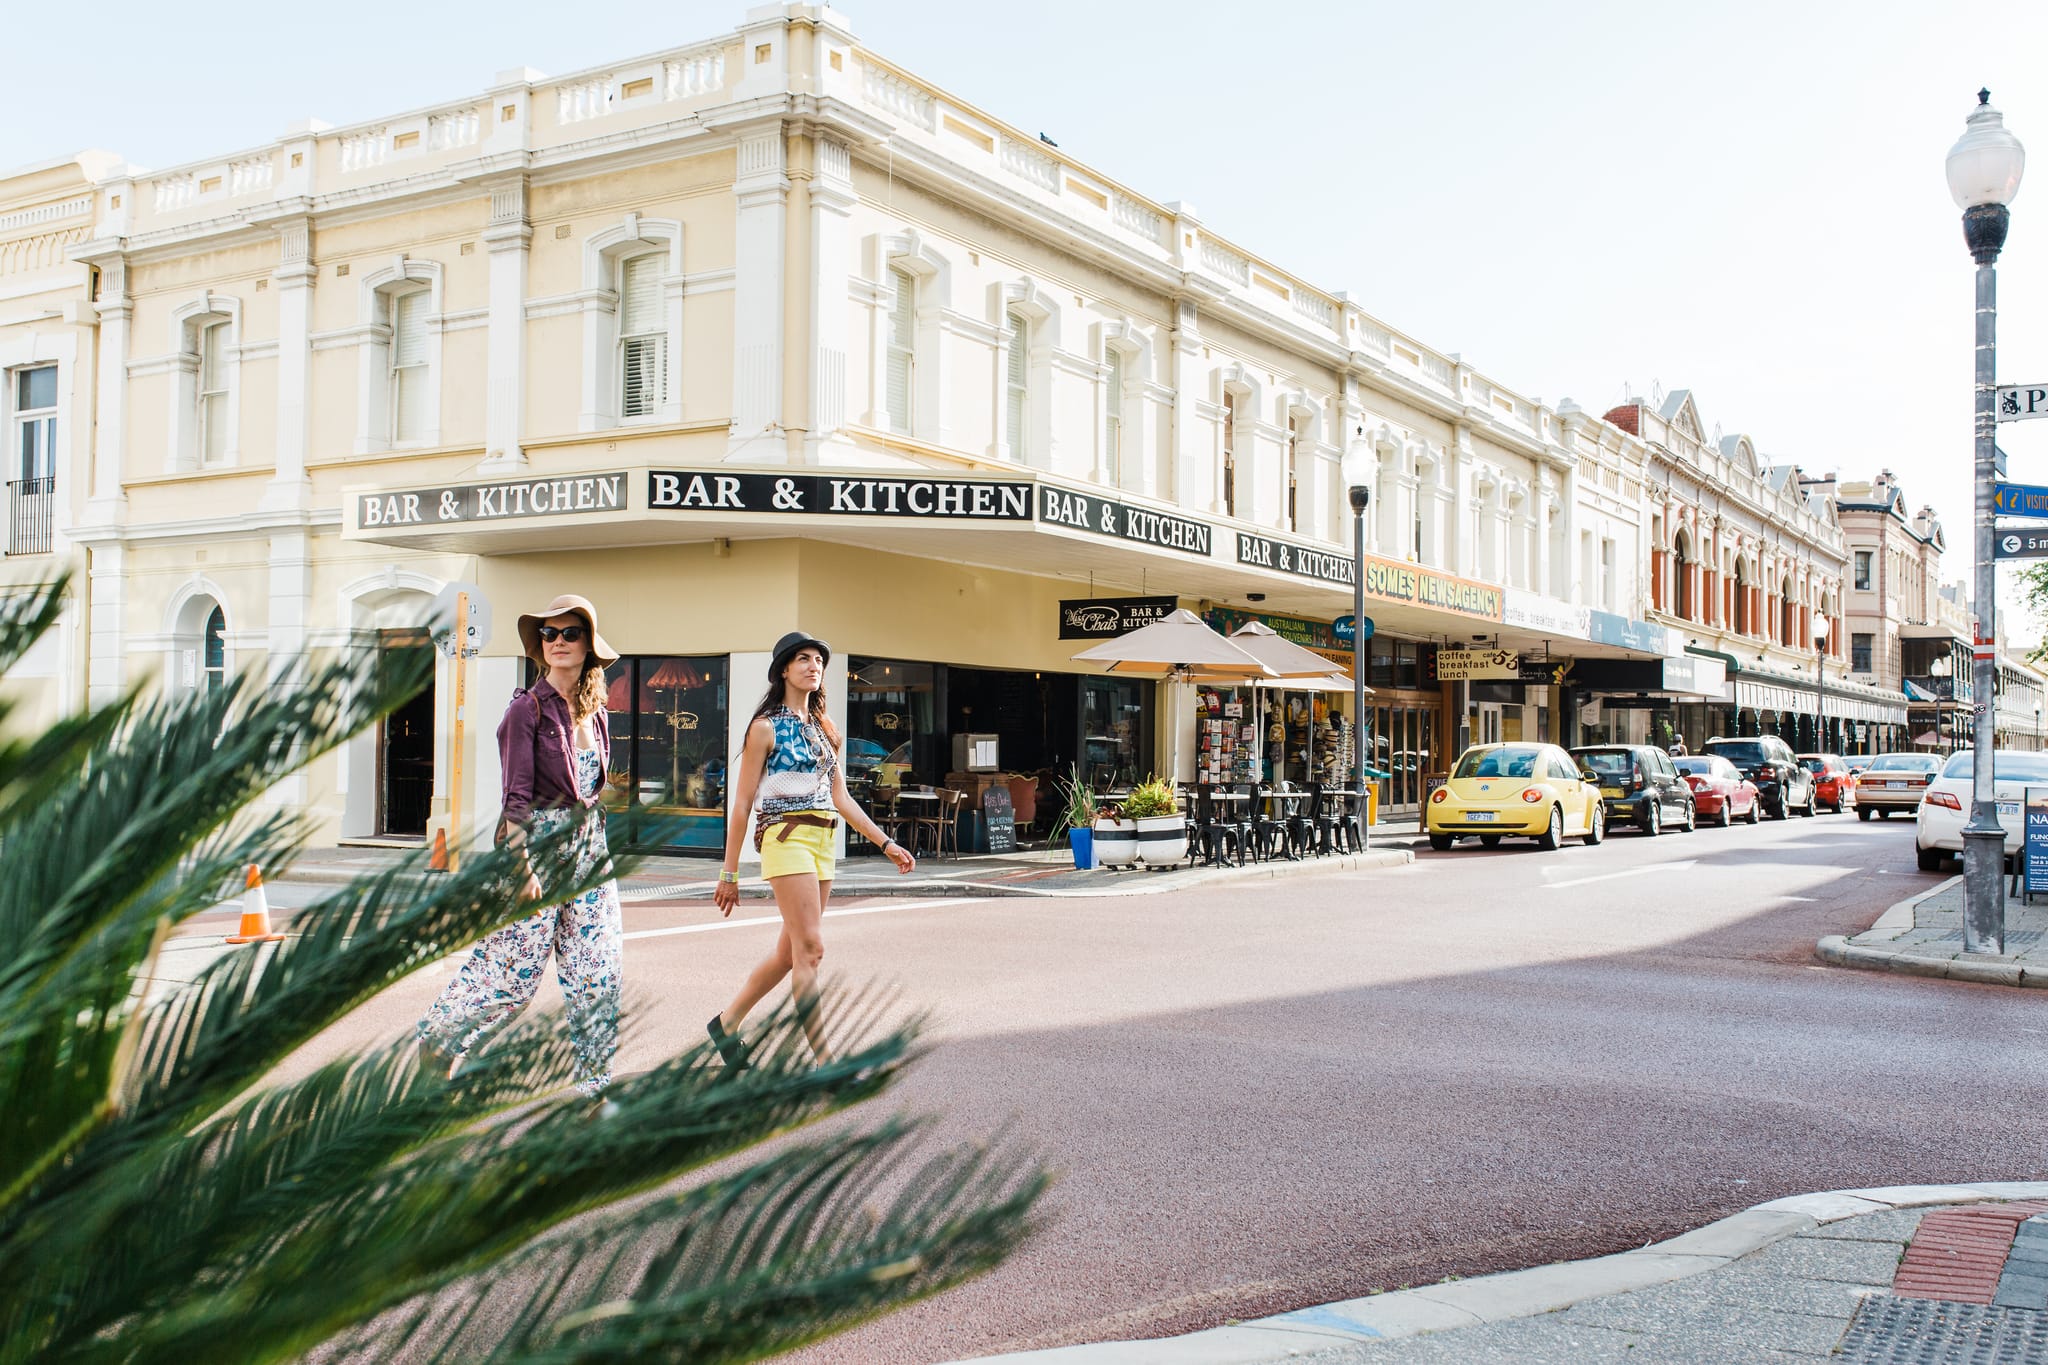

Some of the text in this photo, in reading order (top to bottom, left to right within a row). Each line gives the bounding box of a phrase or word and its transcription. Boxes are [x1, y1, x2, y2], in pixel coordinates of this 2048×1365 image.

[2025, 390, 2048, 413] P
[364, 476, 621, 526] BAR & KITCHEN
[652, 474, 1029, 517] BAR & KITCHEN
[1045, 490, 1209, 553] BAR & KITCHEN
[2028, 538, 2036, 549] 5
[1241, 536, 1355, 584] BAR & KITCHEN
[1367, 561, 1500, 617] SOMES NEWSAGENCY
[1082, 607, 1120, 631] Chats
[1131, 608, 1163, 617] BAR &
[1123, 618, 1161, 628] KITCH
[1268, 617, 1306, 632] AUSTRALIANA
[1439, 652, 1471, 660] coffee
[1440, 660, 1489, 669] breakfast
[1440, 671, 1468, 679] lunch
